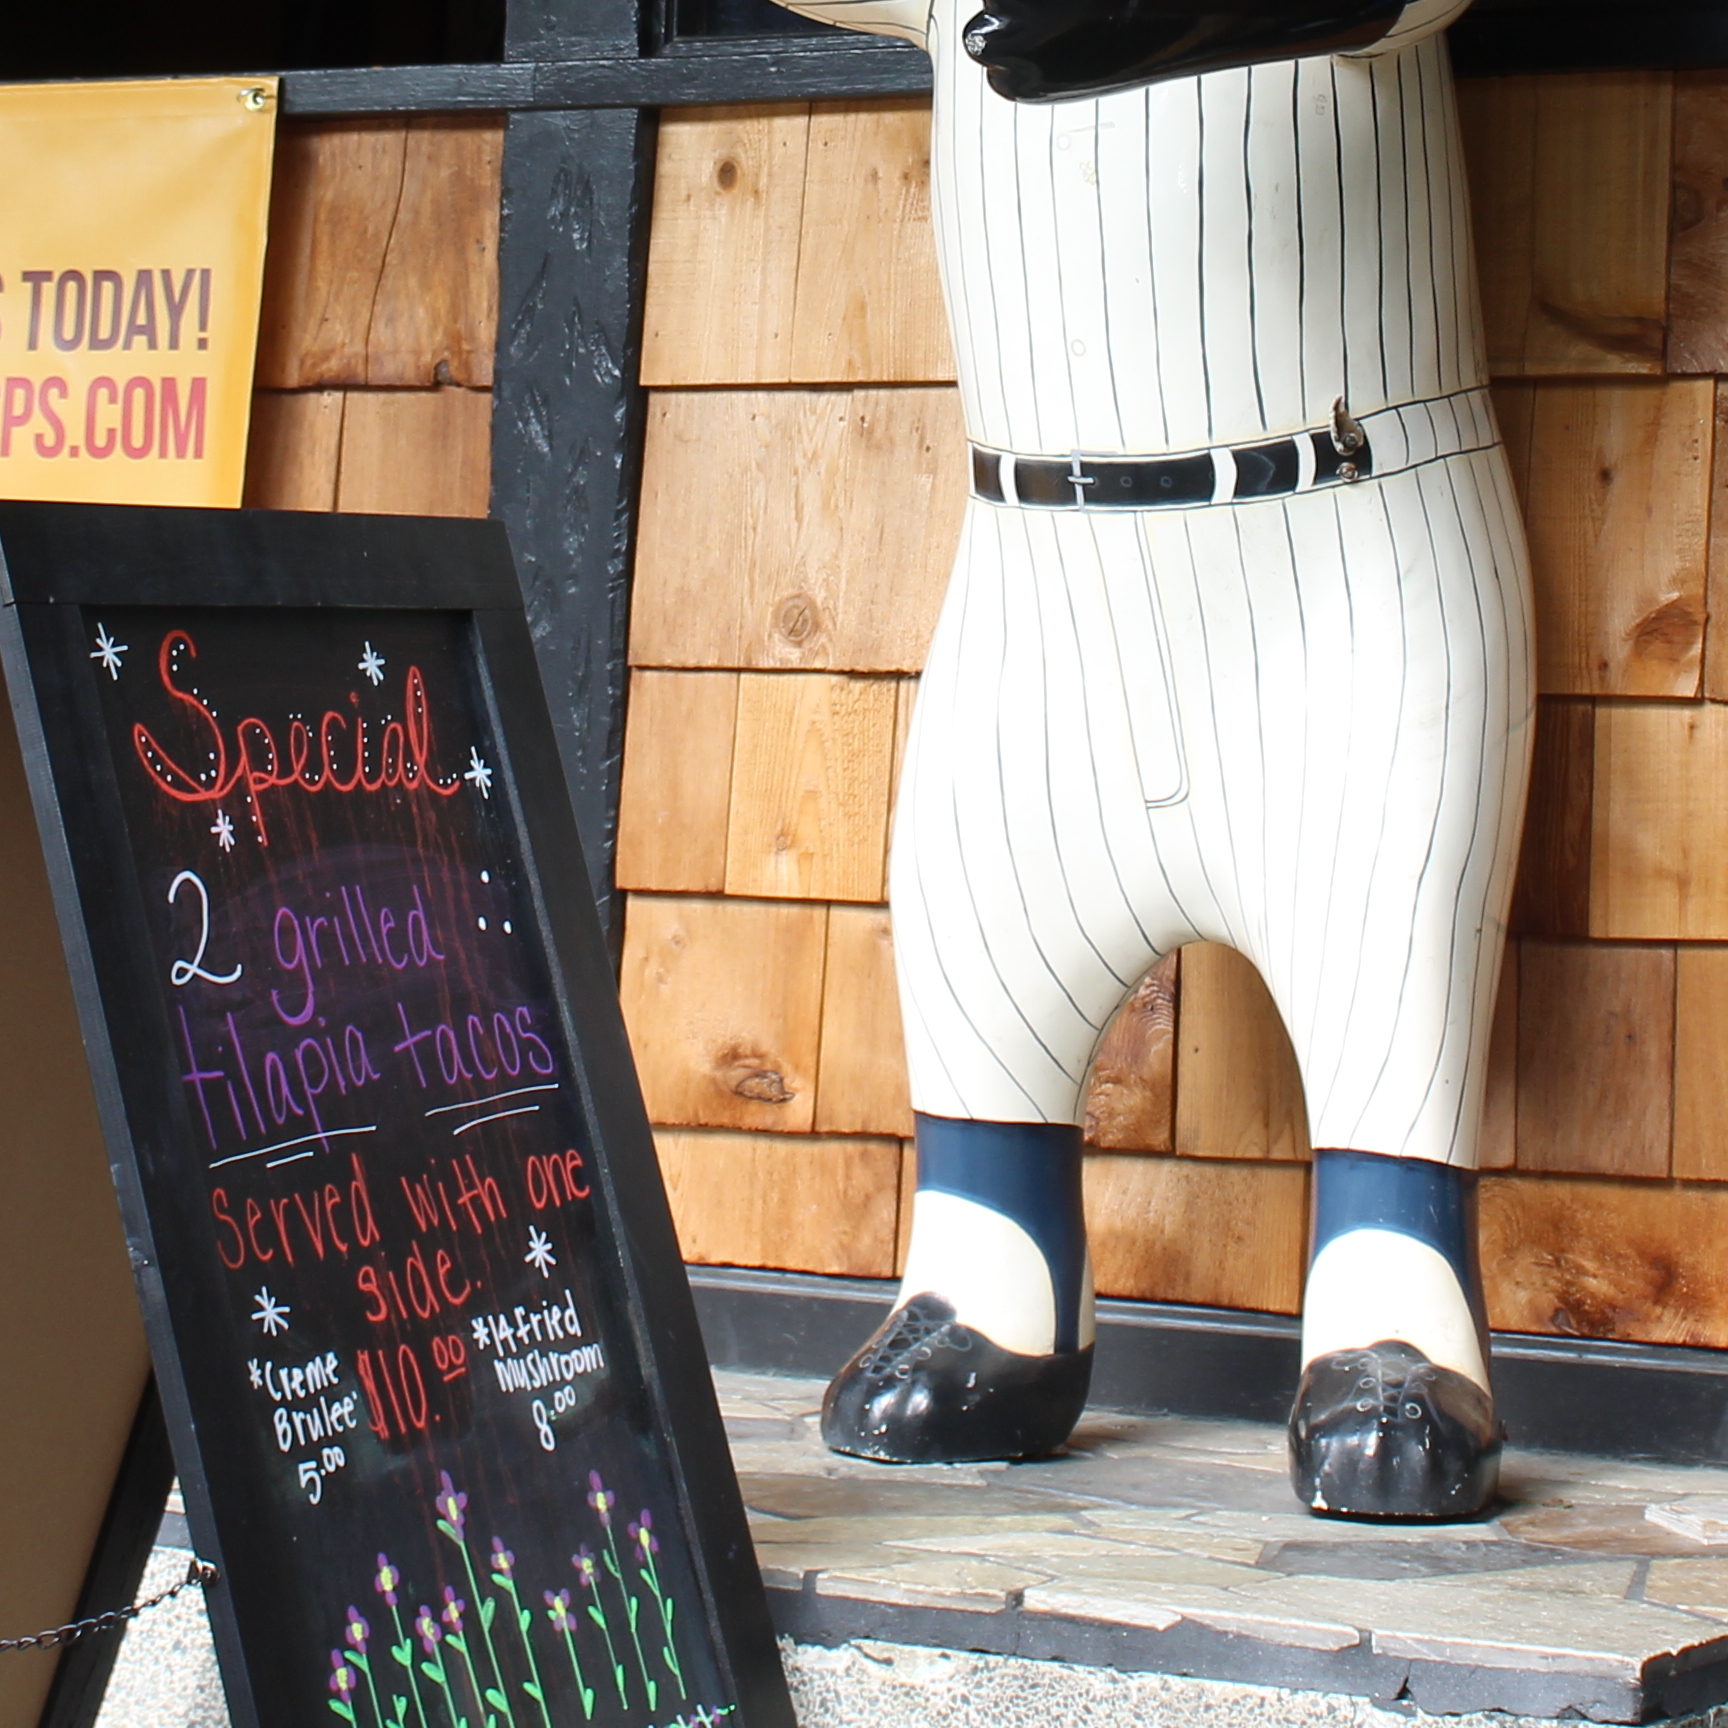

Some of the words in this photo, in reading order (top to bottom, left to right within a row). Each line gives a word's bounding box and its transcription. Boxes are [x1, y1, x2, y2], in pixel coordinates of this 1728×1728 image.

[21, 268, 212, 352] TODAY!
[133, 629, 460, 846] Special
[168, 869, 243, 985] 2
[273, 884, 446, 1026] grilled
[178, 1004, 381, 1154] tilapia
[393, 1001, 555, 1089] tacos
[212, 1152, 380, 1270] Served
[400, 1154, 508, 1234] with
[526, 1148, 591, 1211] one
